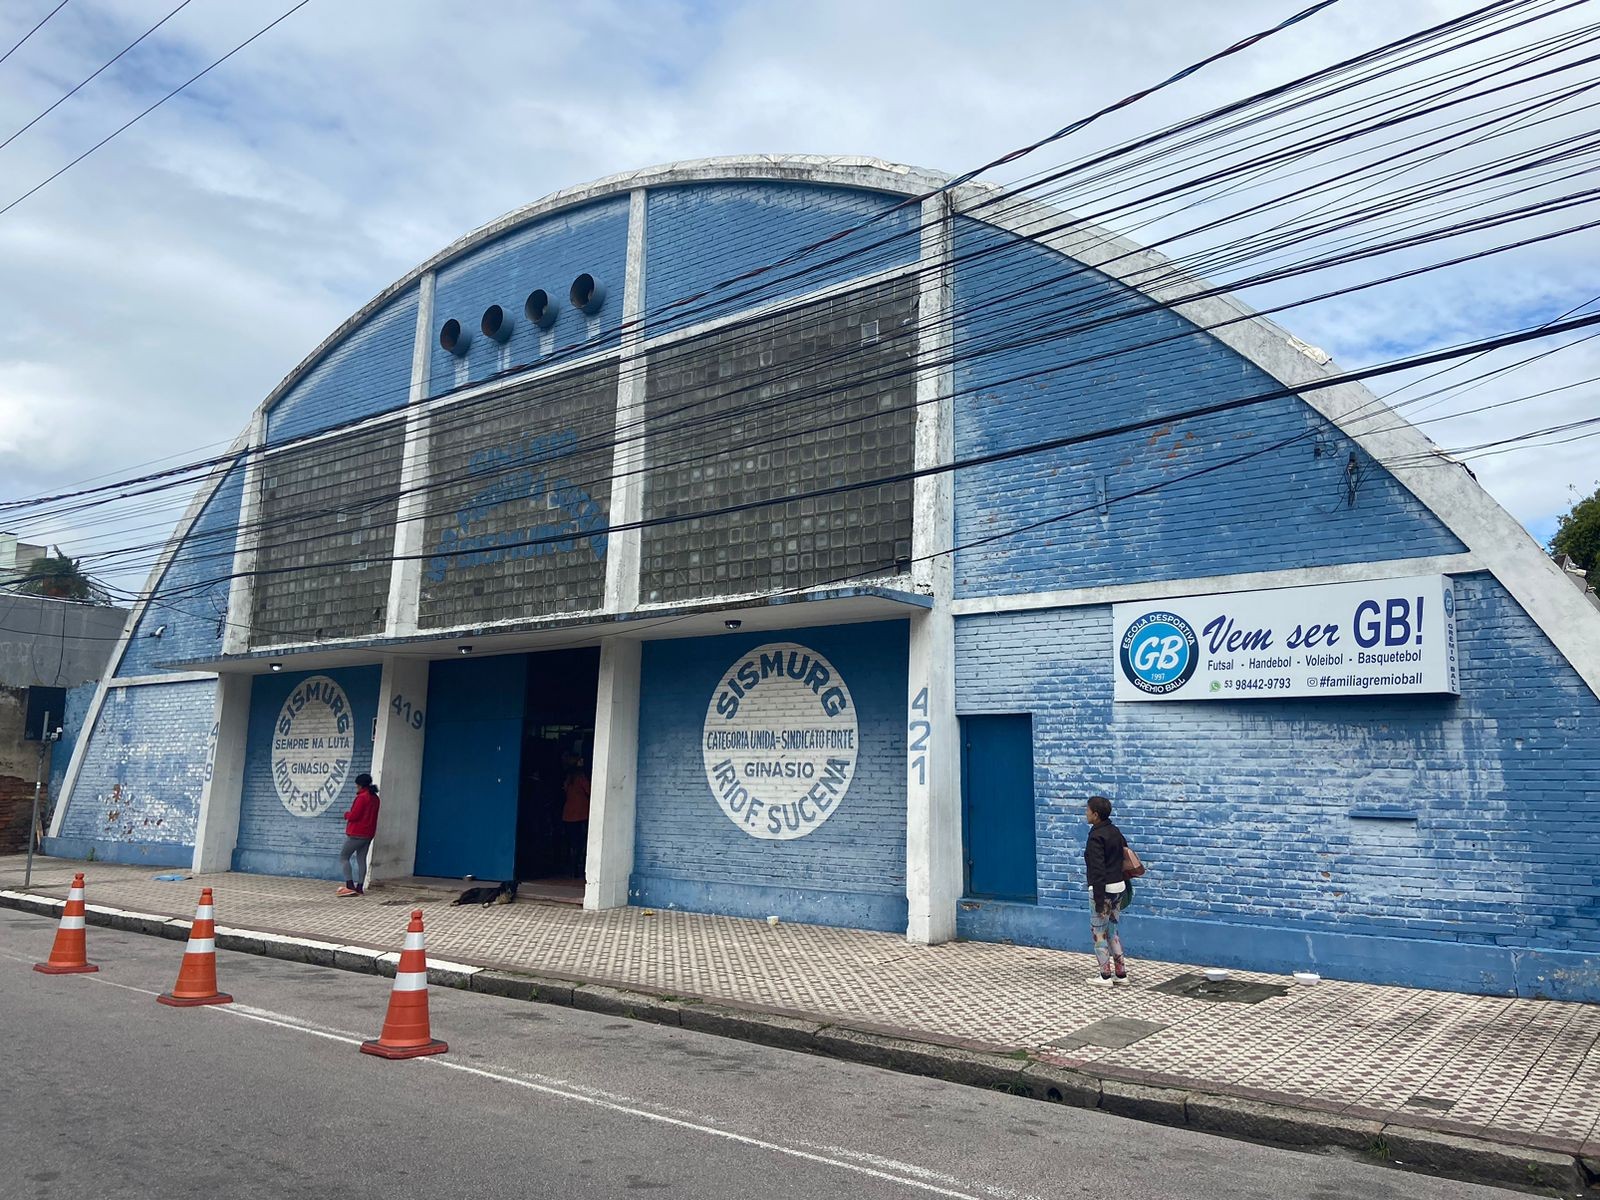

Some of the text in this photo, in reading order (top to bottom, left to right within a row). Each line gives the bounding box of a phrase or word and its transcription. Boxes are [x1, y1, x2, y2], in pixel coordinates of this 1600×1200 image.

[1122, 614, 1195, 649] ESCOLA DESPORTIVA
[1202, 613, 1273, 655] Vem
[1286, 622, 1341, 653] ser
[1353, 596, 1425, 649] GB!
[1134, 635, 1184, 671] GB
[1208, 659, 1234, 670] Futsal
[1249, 656, 1292, 669] Handebol
[1305, 653, 1343, 666] Voleibol
[1358, 649, 1422, 666] Basquetebol
[716, 650, 847, 720] SISMURG
[1151, 673, 1165, 681] 1997
[1165, 678, 1186, 692] BALL
[1224, 672, 1422, 690] 53 98442-9793 #familiagremioball
[278, 681, 350, 737] SISMURG
[391, 694, 424, 730] 419
[204, 721, 219, 782] 419
[275, 737, 350, 750] SEMPRE NA LUTA
[707, 730, 749, 750] CATEGORIA
[826, 729, 854, 750] FORTE
[909, 687, 931, 785] 421
[744, 754, 814, 779] GINÁSIO
[300, 758, 348, 812] SUCENA
[767, 758, 850, 834] SUCENA
